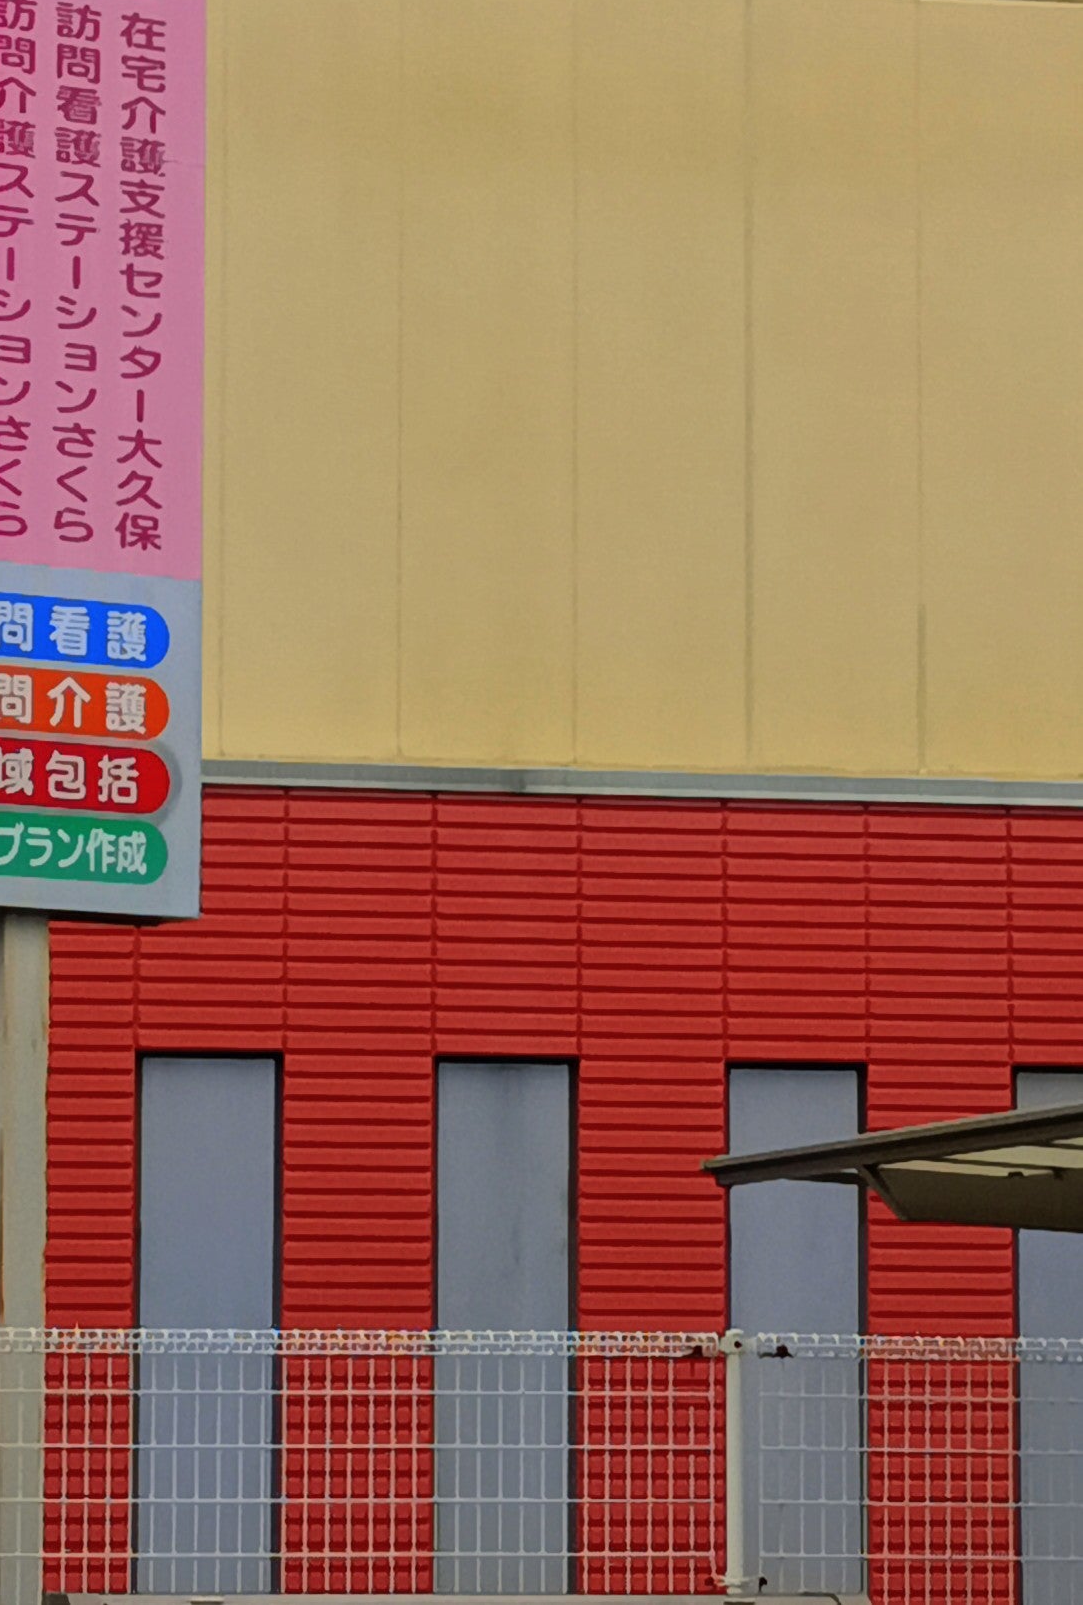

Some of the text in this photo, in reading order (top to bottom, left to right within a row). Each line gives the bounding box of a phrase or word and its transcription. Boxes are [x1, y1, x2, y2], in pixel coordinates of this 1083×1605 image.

[52, 1, 102, 543] 訪問看護ステーションさくら
[115, 12, 167, 551] 在宅介護支援センター大久保
